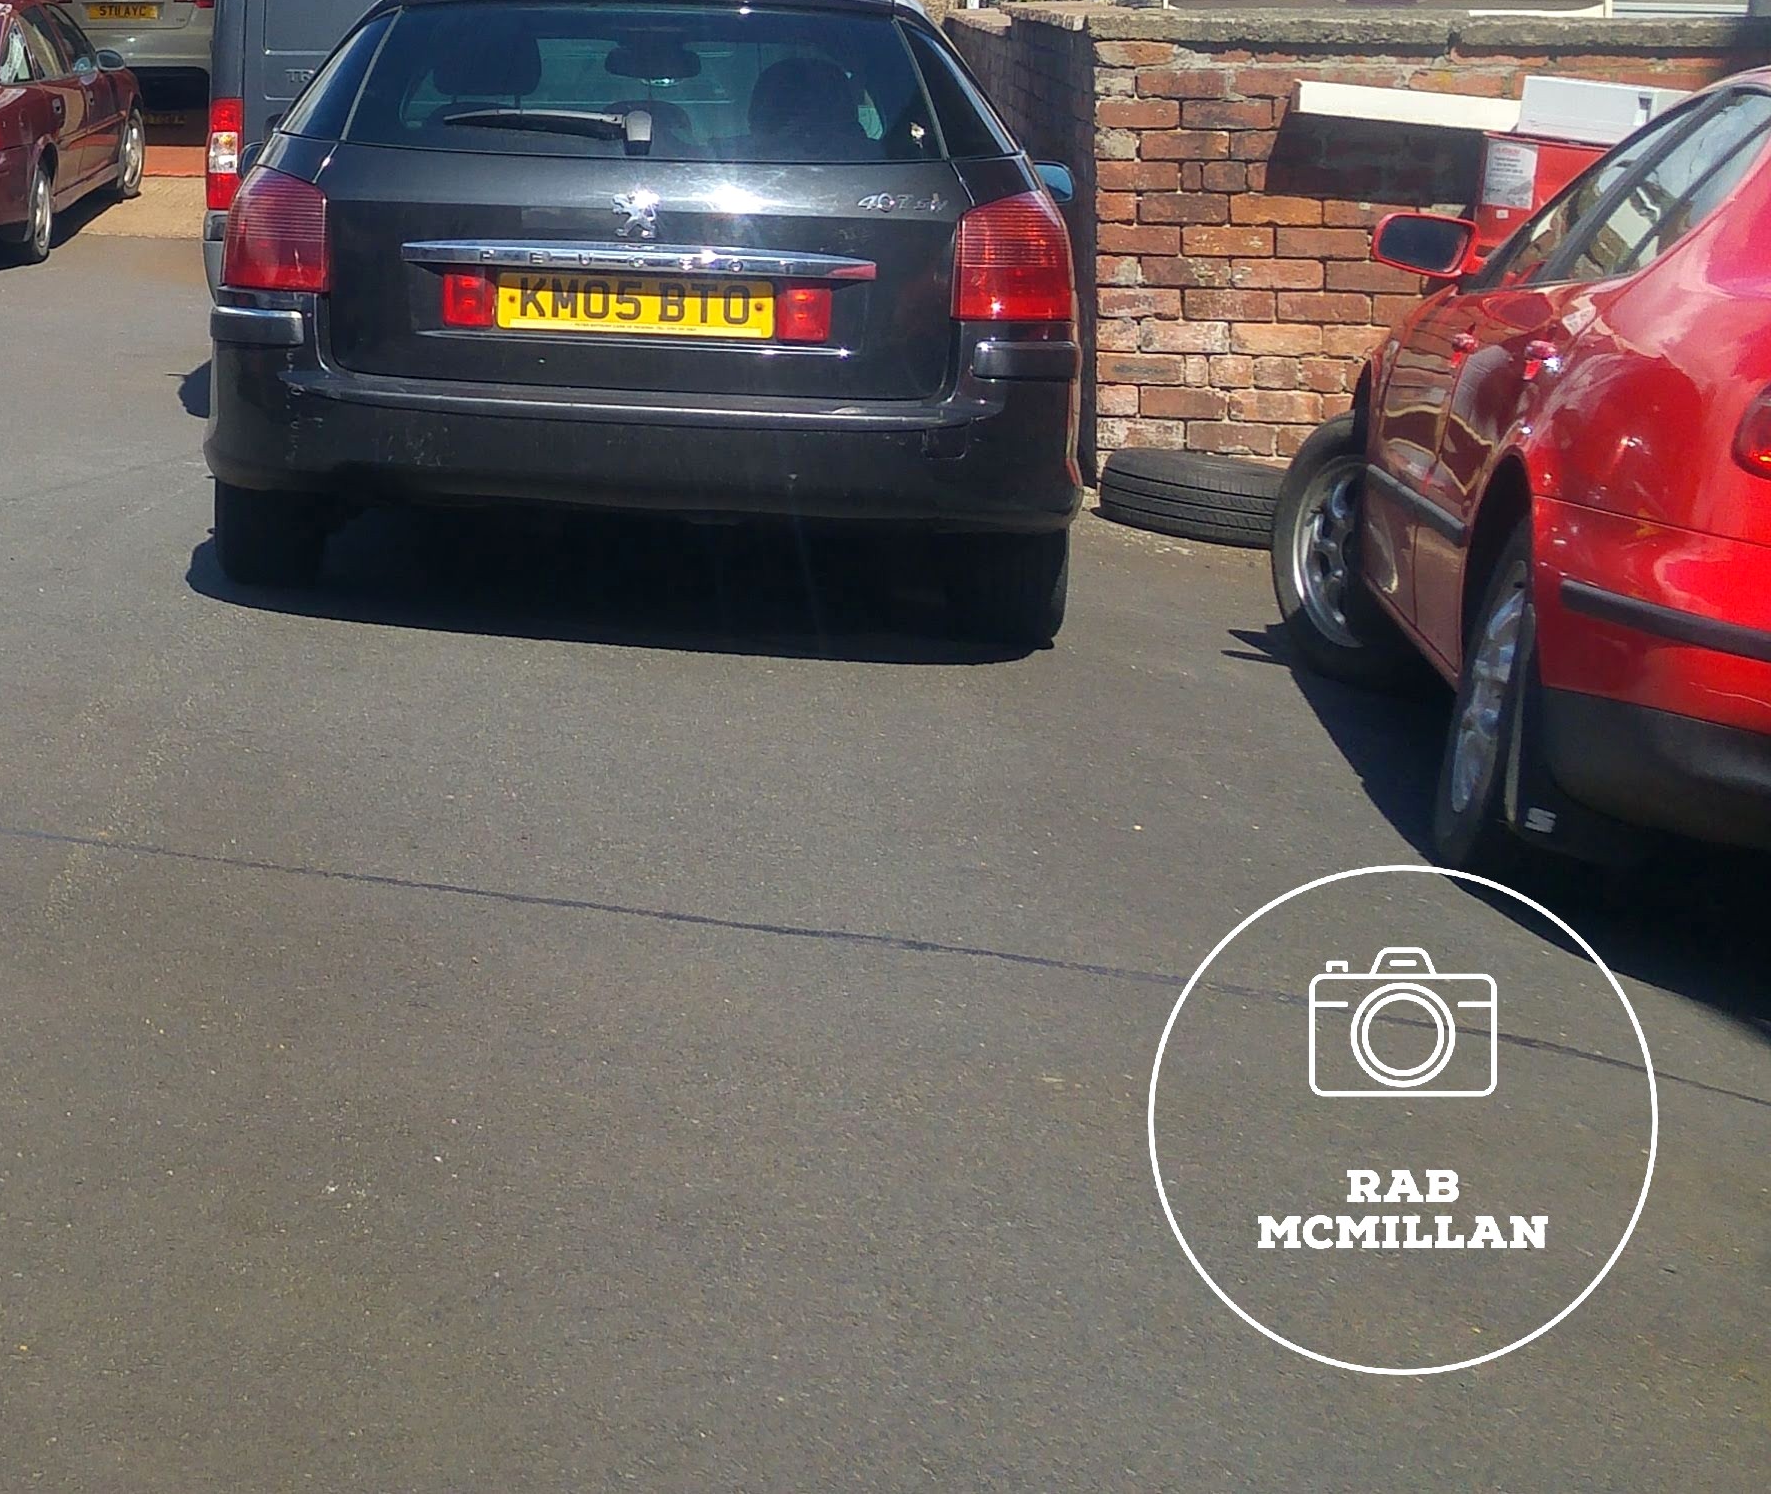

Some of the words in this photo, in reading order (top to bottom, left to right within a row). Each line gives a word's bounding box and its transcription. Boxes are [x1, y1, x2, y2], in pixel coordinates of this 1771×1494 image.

[124, 6, 147, 16] AYC
[857, 193, 914, 213] 407
[519, 276, 643, 322] KM05
[659, 281, 750, 325] BTO
